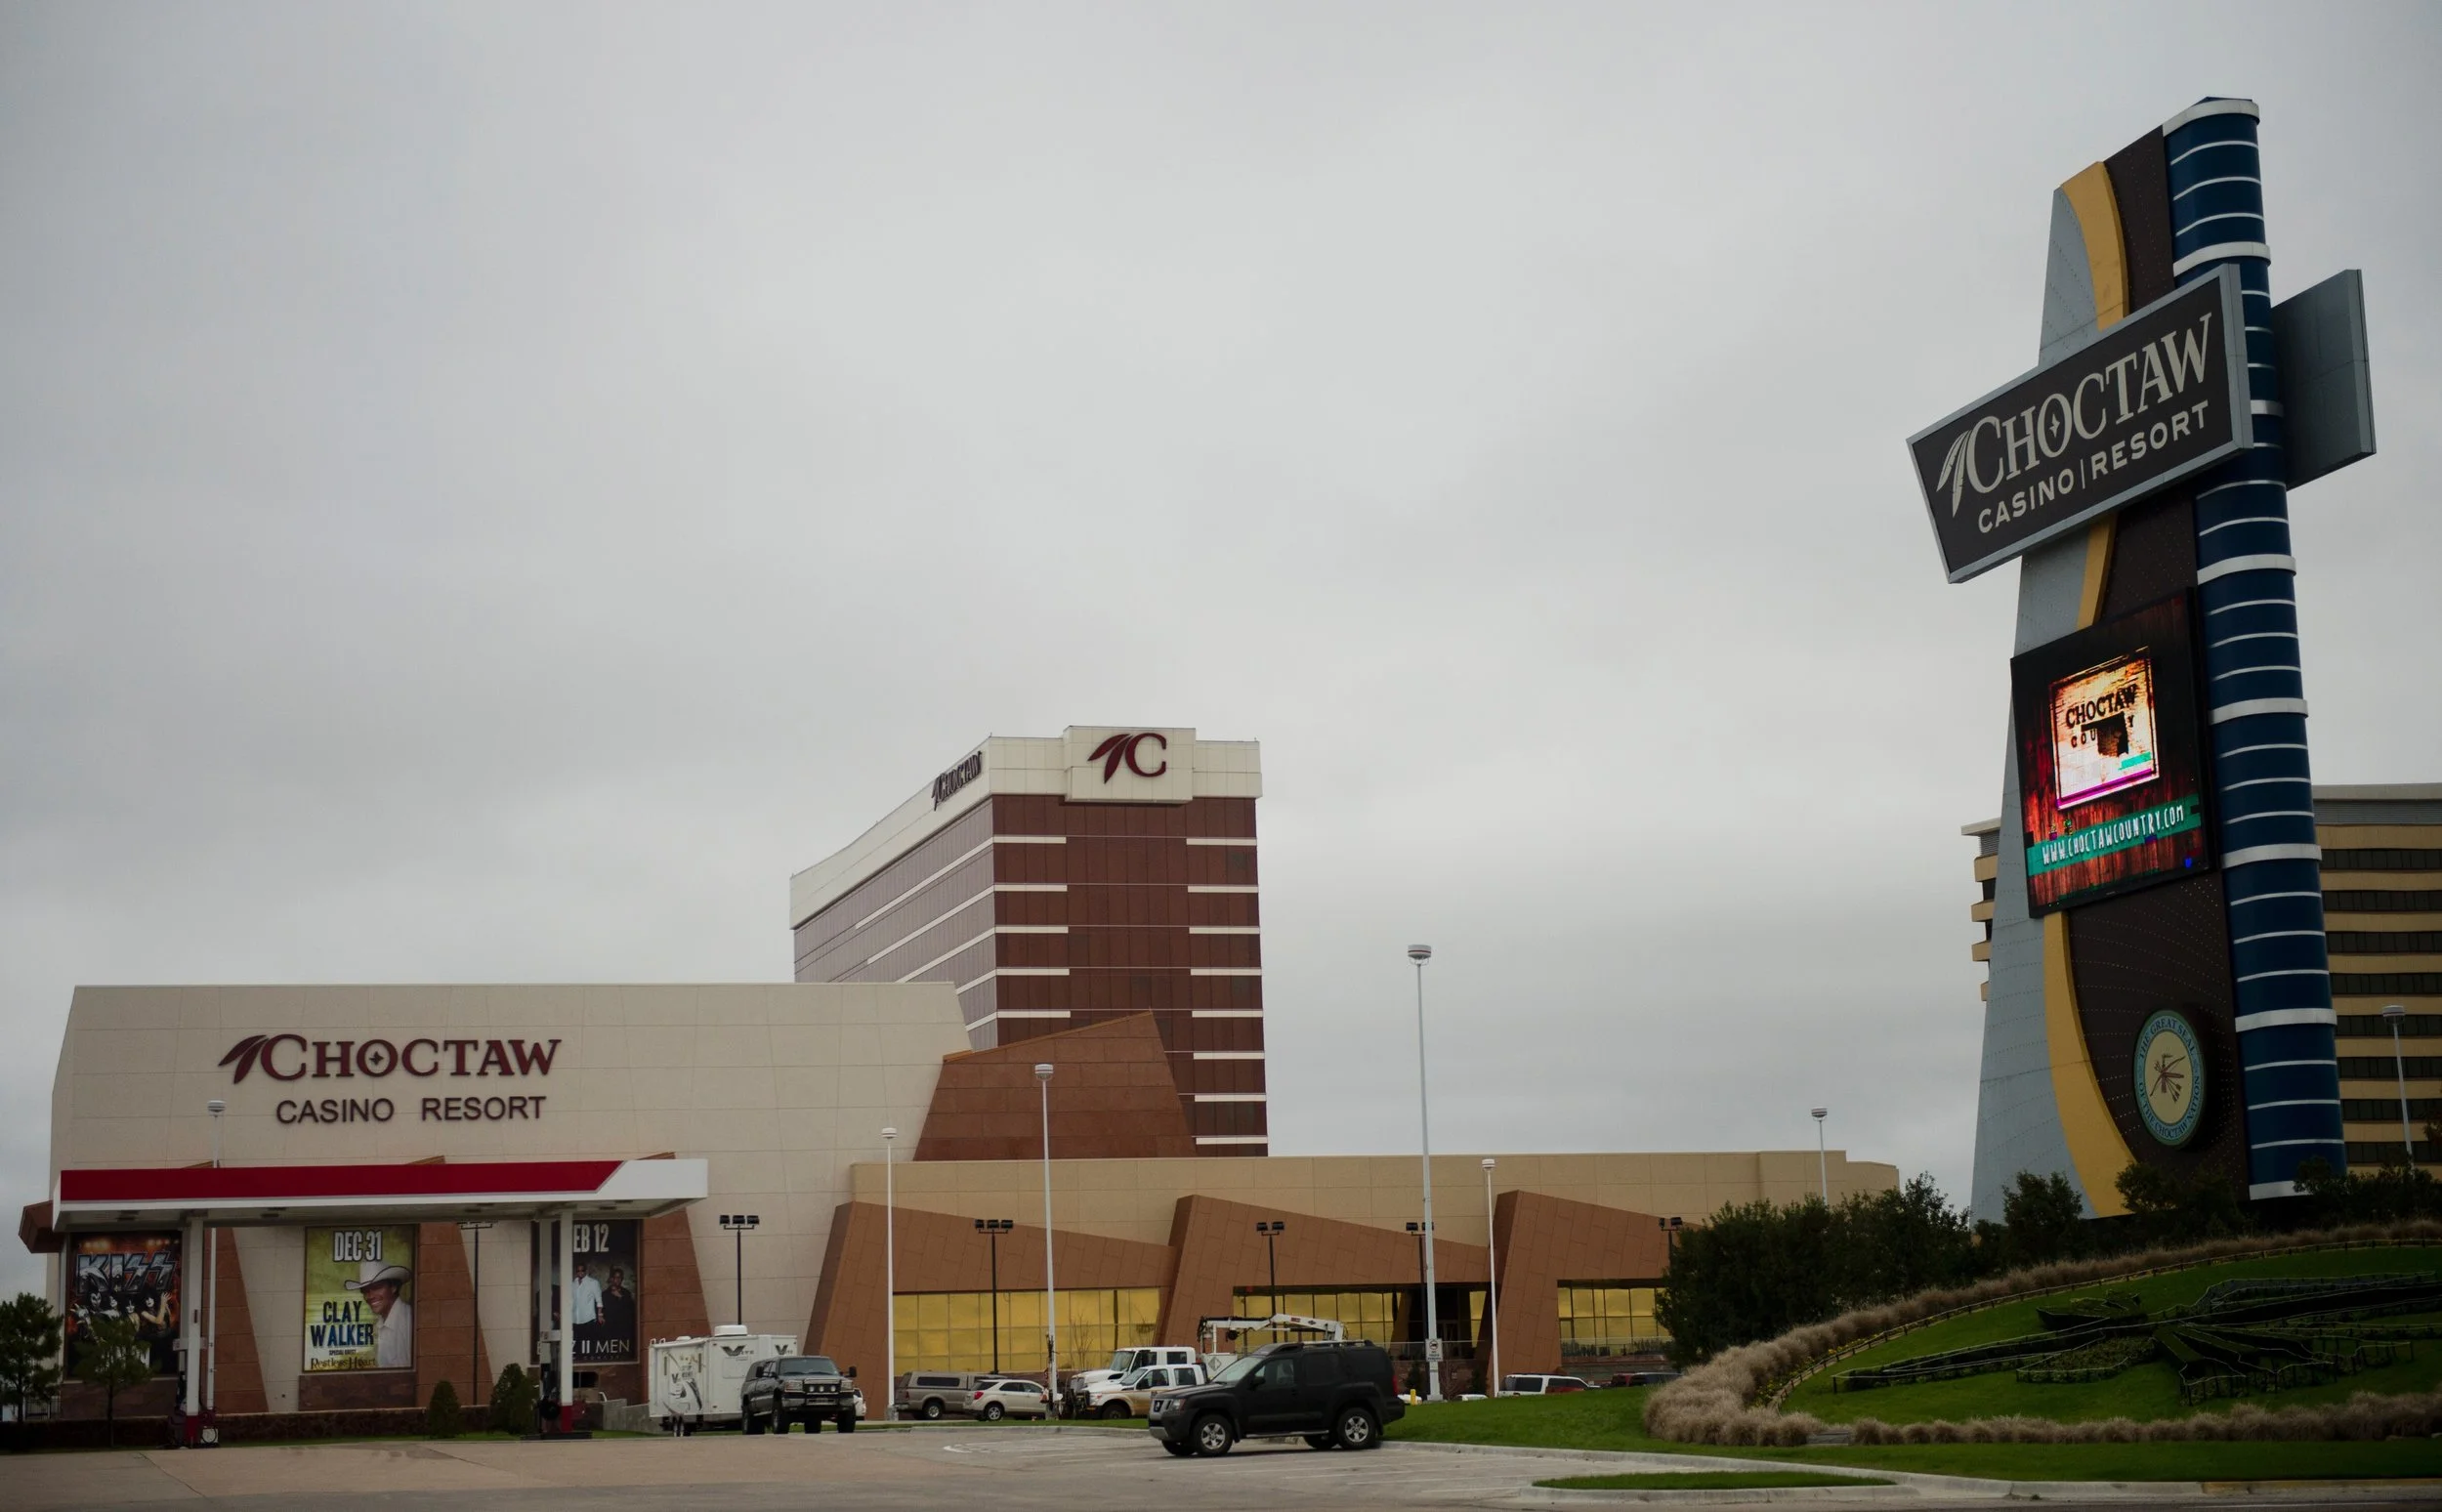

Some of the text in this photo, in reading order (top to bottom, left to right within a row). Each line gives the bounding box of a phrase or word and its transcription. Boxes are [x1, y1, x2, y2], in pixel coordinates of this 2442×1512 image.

[1966, 312, 2212, 494] CHOCTAW
[1978, 399, 2209, 534] CASINO RESORT
[2065, 683, 2139, 729] CHOCTAW
[2071, 715, 2134, 748] COUY
[940, 750, 983, 802] CHOCTAW
[2042, 804, 2184, 865] WWW.CHOCTAWCOUNTRY.COM
[2150, 1018, 2177, 1035] GREAT
[2177, 1024, 2195, 1056] SEAL
[261, 1033, 563, 1081] CHOCTAW
[276, 1096, 547, 1124] CASINO RESORT
[333, 1229, 383, 1262] DEC 31
[572, 1224, 610, 1253] EB 12
[76, 1251, 178, 1296] KISS
[322, 1300, 362, 1323] CLAY
[310, 1323, 374, 1347] WALKER
[595, 1339, 630, 1354] MEN
